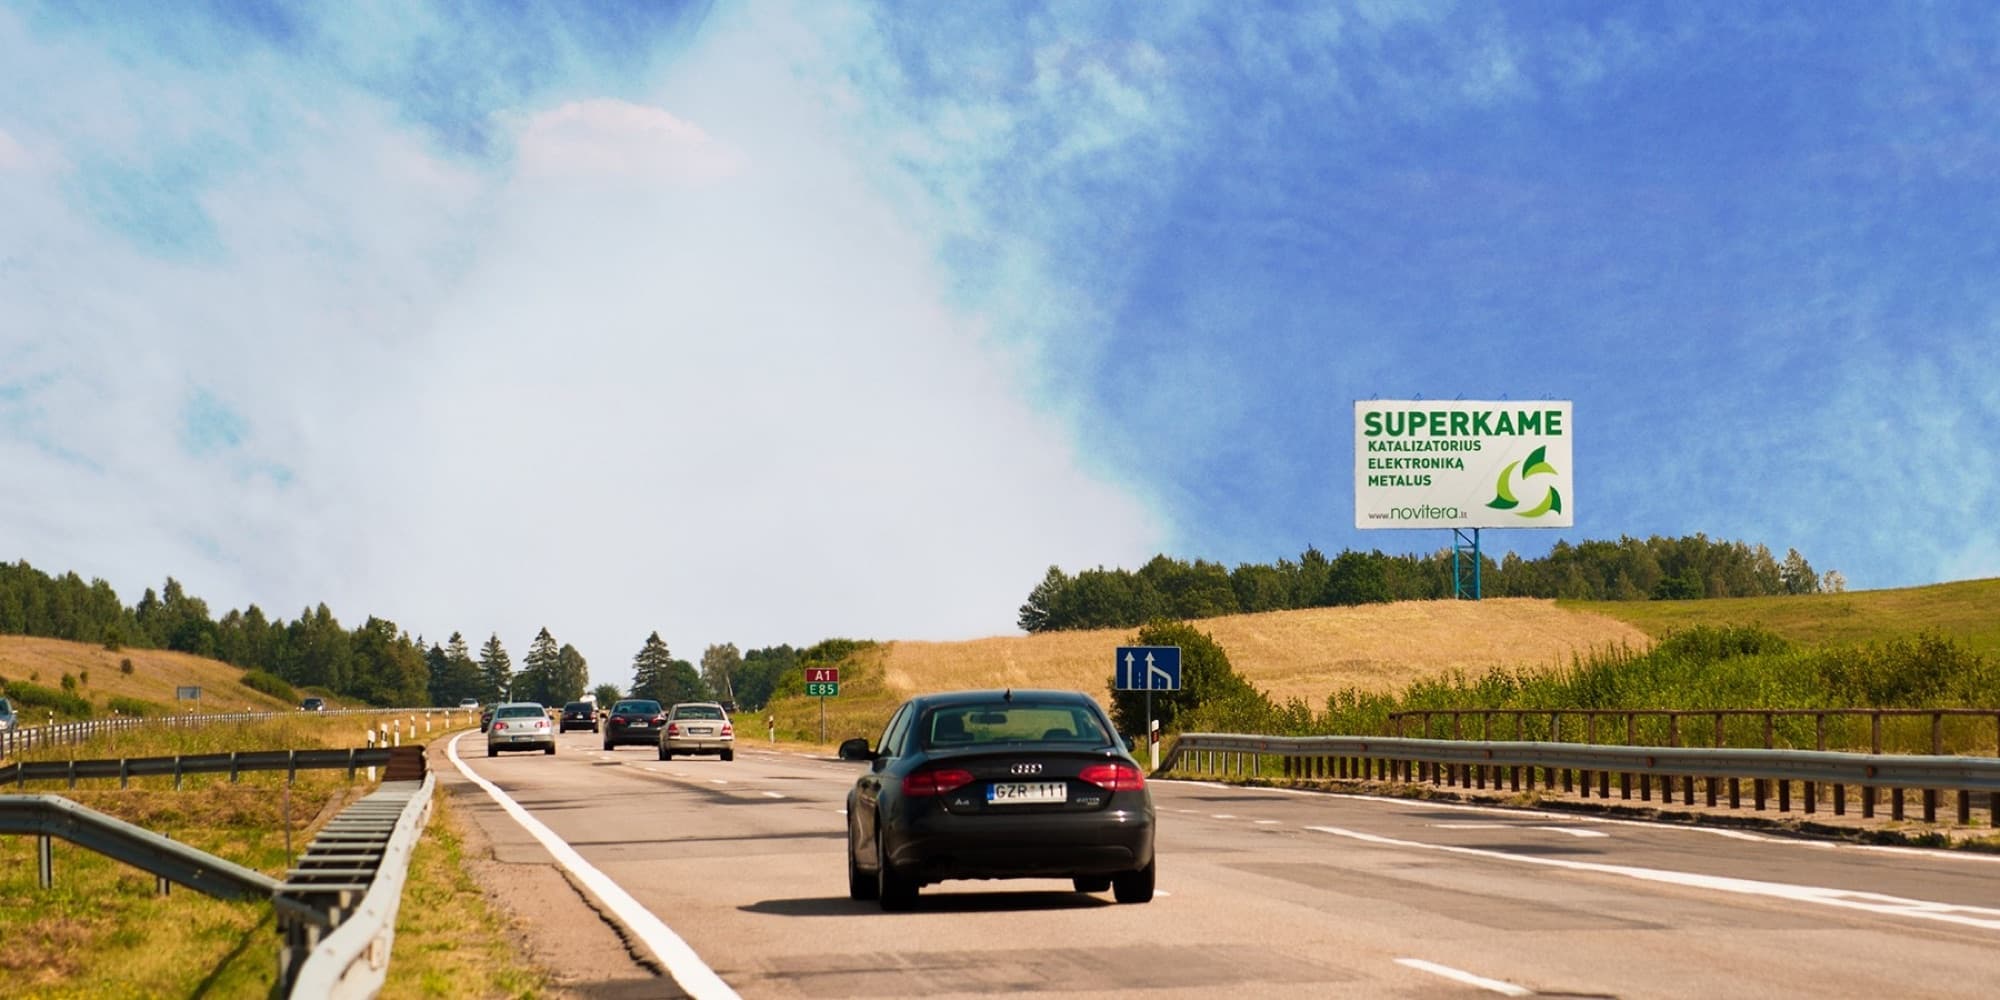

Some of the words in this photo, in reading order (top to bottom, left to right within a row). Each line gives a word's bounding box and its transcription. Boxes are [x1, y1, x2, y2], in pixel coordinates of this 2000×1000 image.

[1364, 410, 1563, 437] SUPERKAME
[1368, 440, 1481, 452] KATALIZATORIUS
[1368, 457, 1464, 471] ELEKTRONIKĄ
[1368, 475, 1432, 487] METALUS
[1368, 504, 1468, 520] www.novitera.lt
[815, 670, 830, 681] A1
[810, 684, 834, 695] E85
[996, 784, 1027, 798] GZR
[1039, 783, 1064, 797] 111
